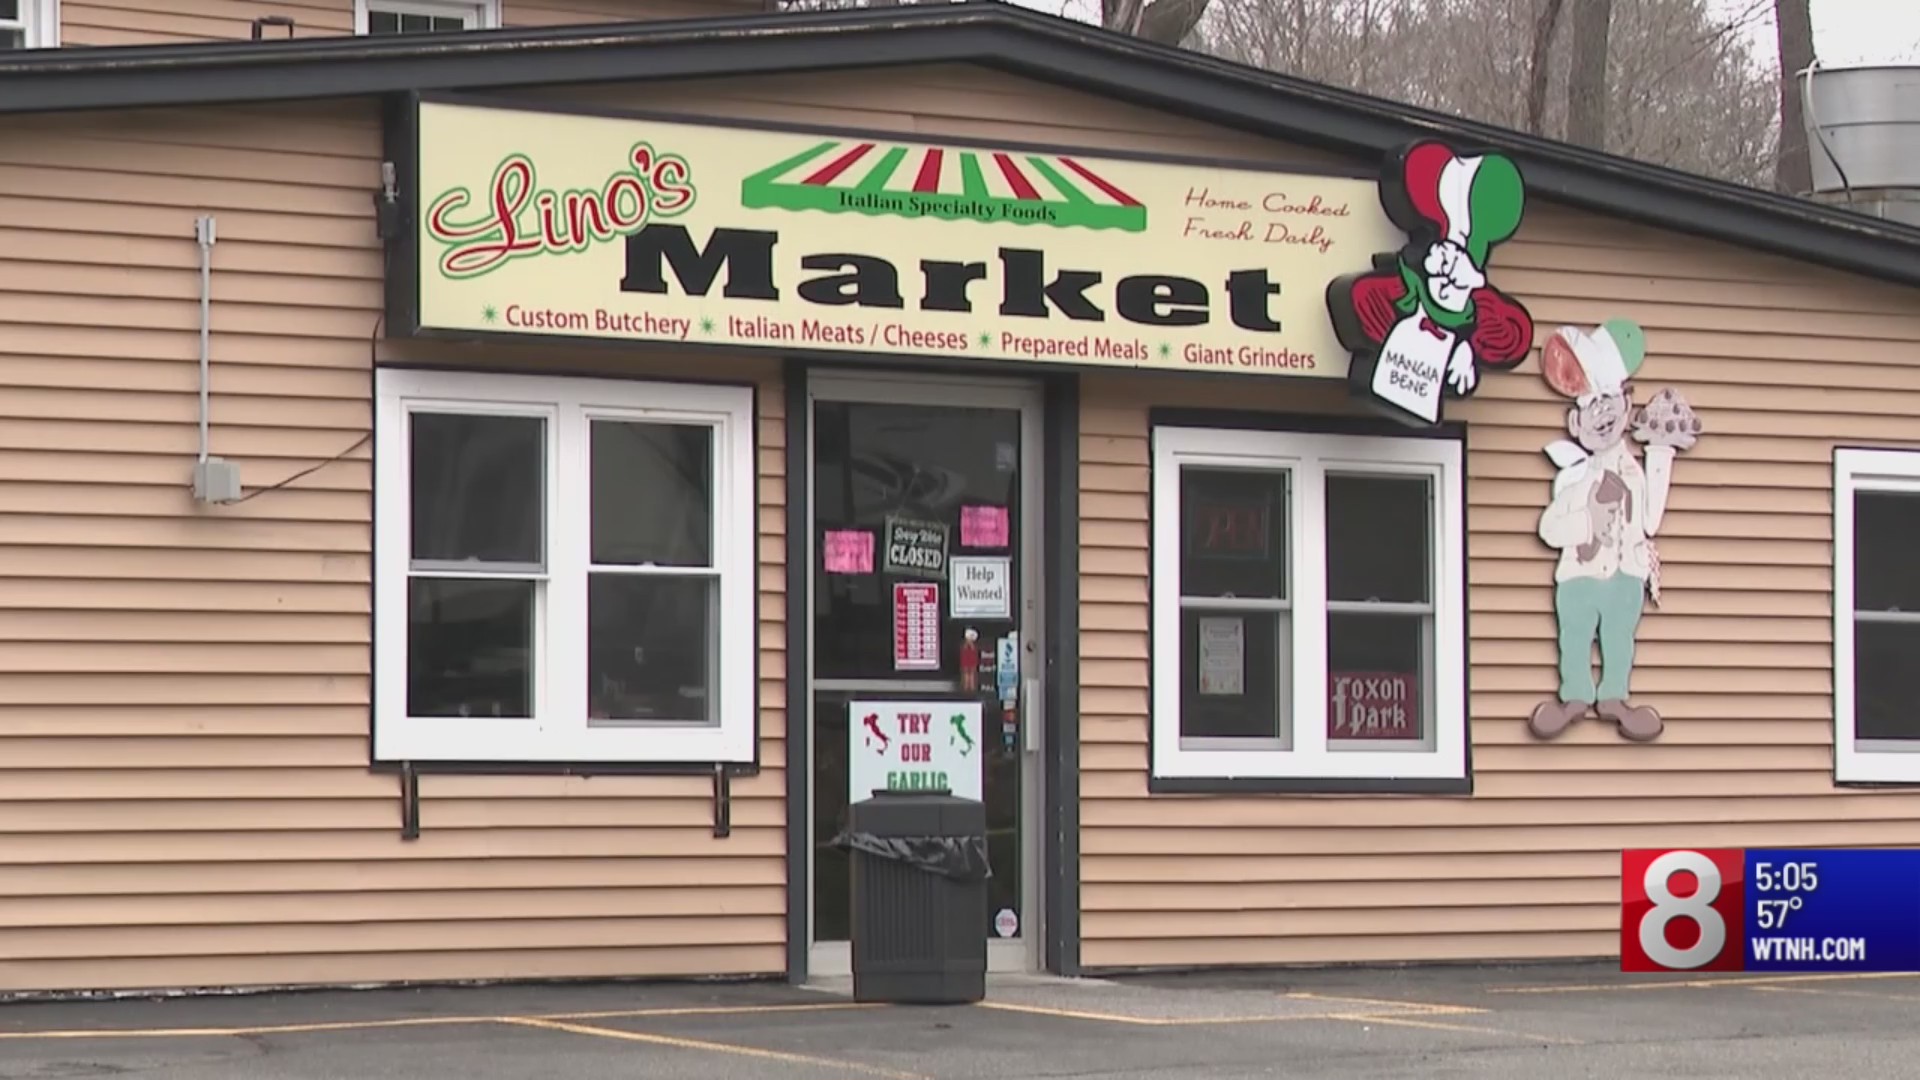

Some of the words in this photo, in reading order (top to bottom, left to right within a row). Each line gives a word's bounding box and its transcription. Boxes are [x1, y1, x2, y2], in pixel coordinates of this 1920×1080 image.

[427, 142, 695, 278] Lino's
[839, 191, 903, 210] Italian
[908, 196, 996, 219] Specialty
[1001, 203, 1057, 221] Foods
[1184, 187, 1252, 209] Home
[1262, 192, 1351, 217] Cooked
[1183, 217, 1255, 241] Fresh
[1263, 222, 1335, 253] Daily
[620, 223, 1282, 332] Market
[505, 304, 589, 330] Custom
[594, 308, 691, 341] Butchery
[728, 315, 795, 341] Italian
[801, 319, 865, 344] Meats
[883, 324, 969, 349] Cheeses
[1001, 332, 1089, 359] Prepared
[1094, 338, 1149, 361] Meals
[1184, 343, 1234, 366] Giant
[1238, 346, 1316, 370] Grinders
[1385, 350, 1439, 383] MANGIA
[1389, 369, 1429, 397] BENE
[890, 544, 943, 568] CLOSED
[966, 566, 995, 583] Help
[957, 585, 1003, 601] Wanted
[1332, 677, 1407, 731] Foxon
[897, 713, 932, 734] TRY
[1349, 702, 1407, 737] Park
[900, 743, 932, 762] OUR
[886, 771, 949, 791] GARLIC
